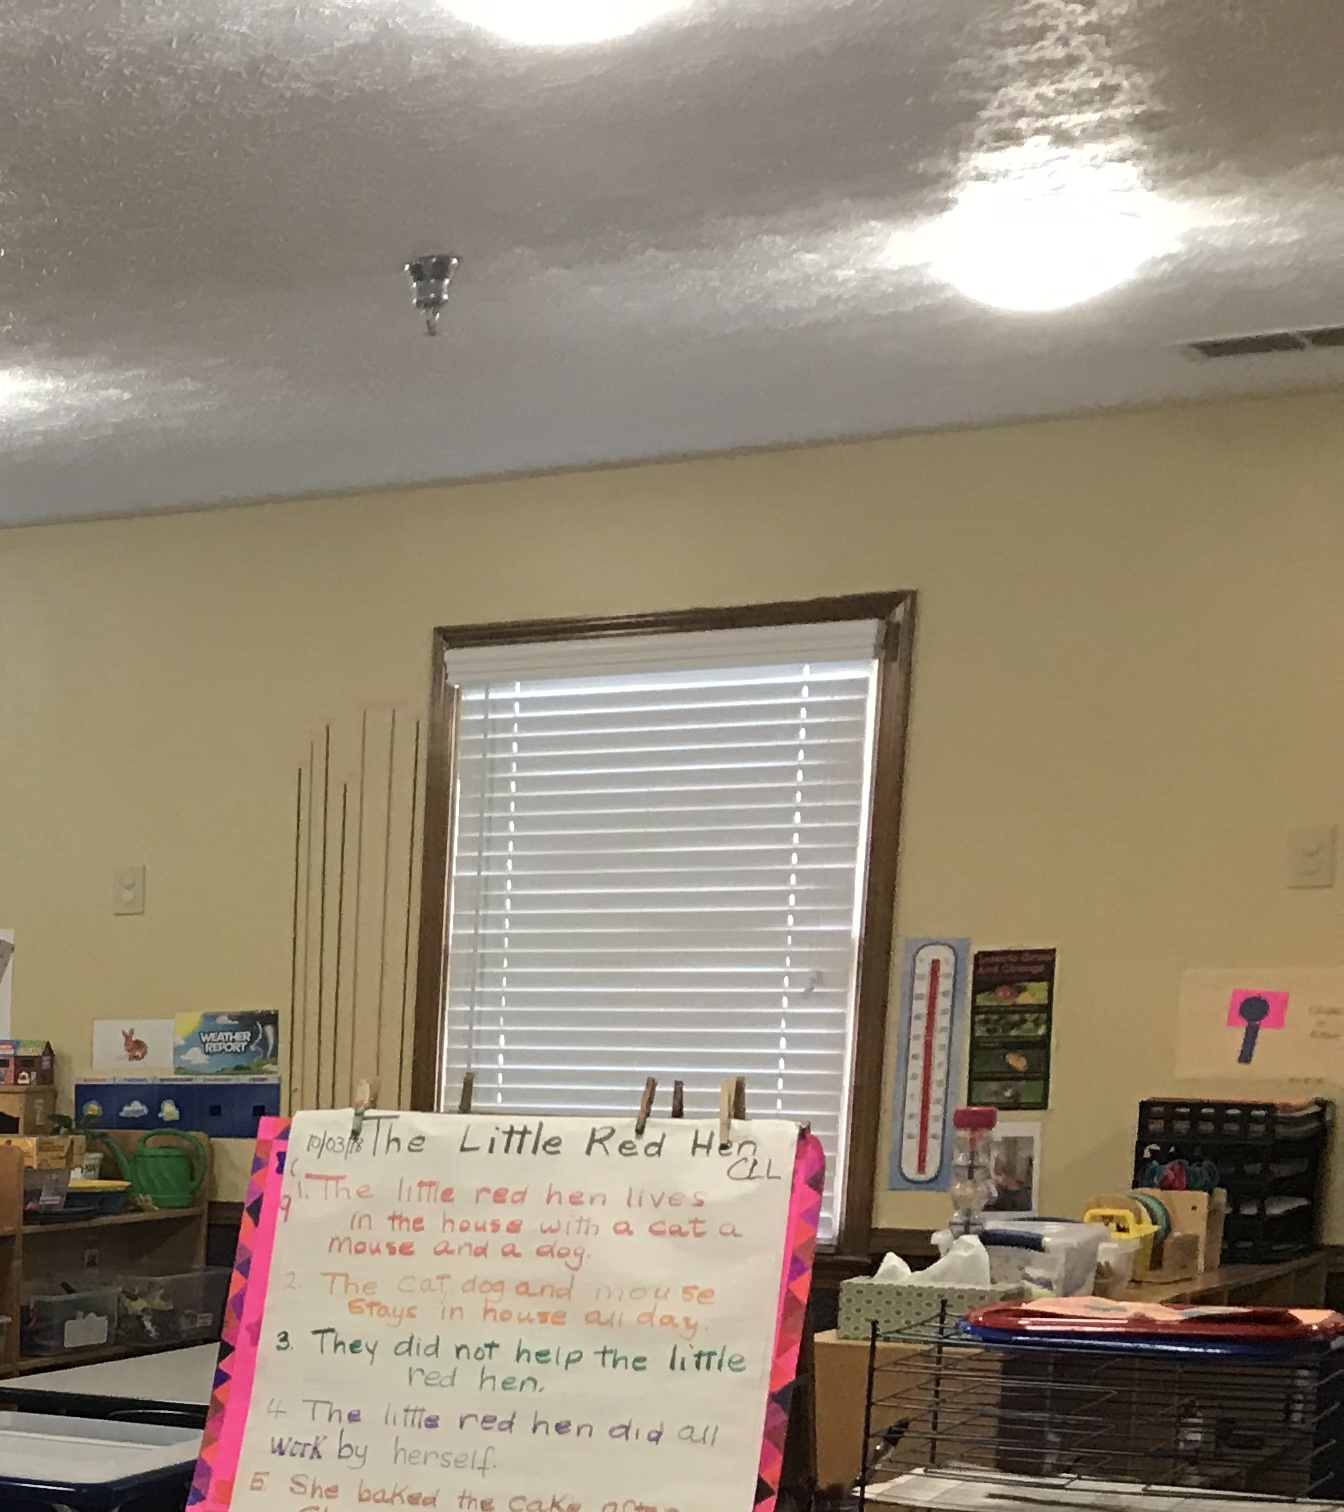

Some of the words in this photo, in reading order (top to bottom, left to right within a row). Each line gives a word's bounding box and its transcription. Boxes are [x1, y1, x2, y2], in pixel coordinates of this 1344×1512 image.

[200, 1030, 251, 1043] WEATHER
[204, 1041, 248, 1054] REPORT
[363, 1115, 426, 1156] The
[459, 1121, 562, 1156] Little
[586, 1126, 666, 1157] Red
[692, 1129, 757, 1157] Hen
[305, 1173, 374, 1200] The
[398, 1176, 455, 1203] little
[475, 1184, 529, 1205] red
[546, 1183, 607, 1207] hen
[627, 1187, 705, 1208] lives
[350, 1211, 372, 1231] in
[387, 1210, 425, 1233] the
[442, 1211, 523, 1235] house
[540, 1214, 599, 1236] with
[613, 1219, 634, 1236] a
[648, 1217, 708, 1238] cat
[719, 1222, 743, 1238] a
[433, 1239, 489, 1259] and
[501, 1242, 522, 1259] a
[535, 1240, 591, 1272] dog.
[320, 1271, 378, 1295] The
[461, 1275, 505, 1301] dog
[515, 1274, 574, 1300] and
[595, 1284, 716, 1305] mouse
[441, 1299, 463, 1321] in
[483, 1297, 566, 1326] house
[584, 1309, 623, 1328] all
[311, 1327, 378, 1365] They
[394, 1332, 440, 1358] did
[455, 1339, 500, 1361] not
[515, 1338, 583, 1371] help
[594, 1344, 648, 1371] the
[669, 1343, 746, 1372] little
[408, 1365, 458, 1387] red
[302, 1399, 361, 1424] The
[384, 1402, 439, 1429] little
[459, 1411, 516, 1434] red
[532, 1410, 594, 1438] hen
[608, 1418, 663, 1445] did
[678, 1424, 718, 1446] all
[337, 1428, 368, 1470] by
[393, 1436, 497, 1478] herself.
[289, 1473, 339, 1499] She
[358, 1478, 440, 1507] baked
[458, 1489, 495, 1512] the
